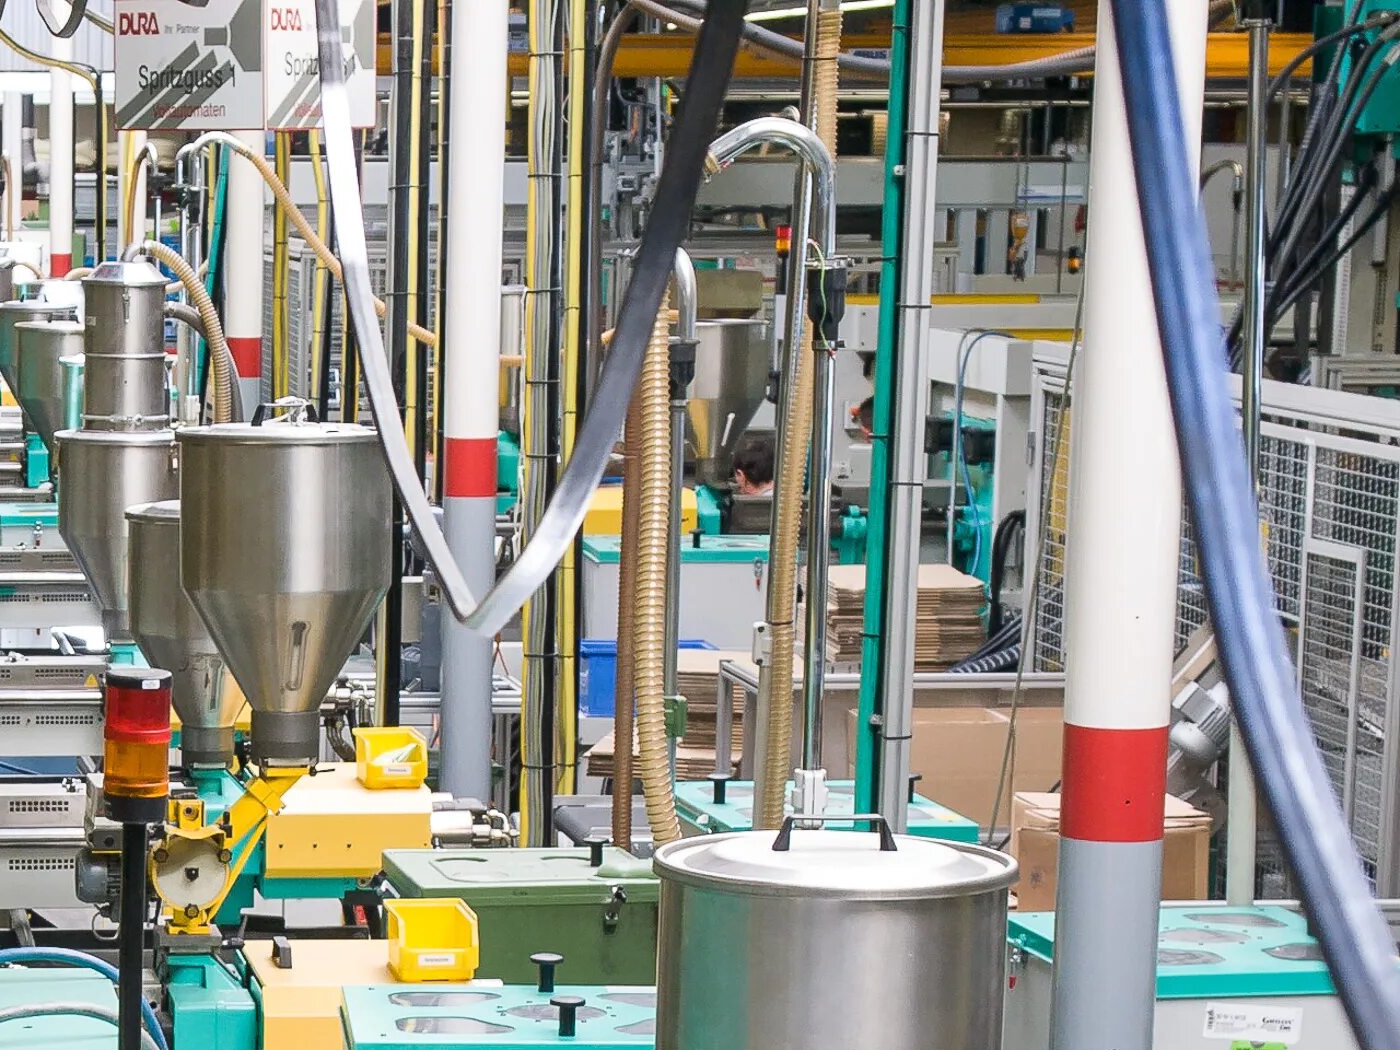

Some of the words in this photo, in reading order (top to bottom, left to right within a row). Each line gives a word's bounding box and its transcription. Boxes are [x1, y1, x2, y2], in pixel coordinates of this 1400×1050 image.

[119, 12, 159, 36] DURA
[271, 8, 302, 32] DURA
[138, 65, 223, 94] Spritzguss
[229, 65, 236, 87] 1
